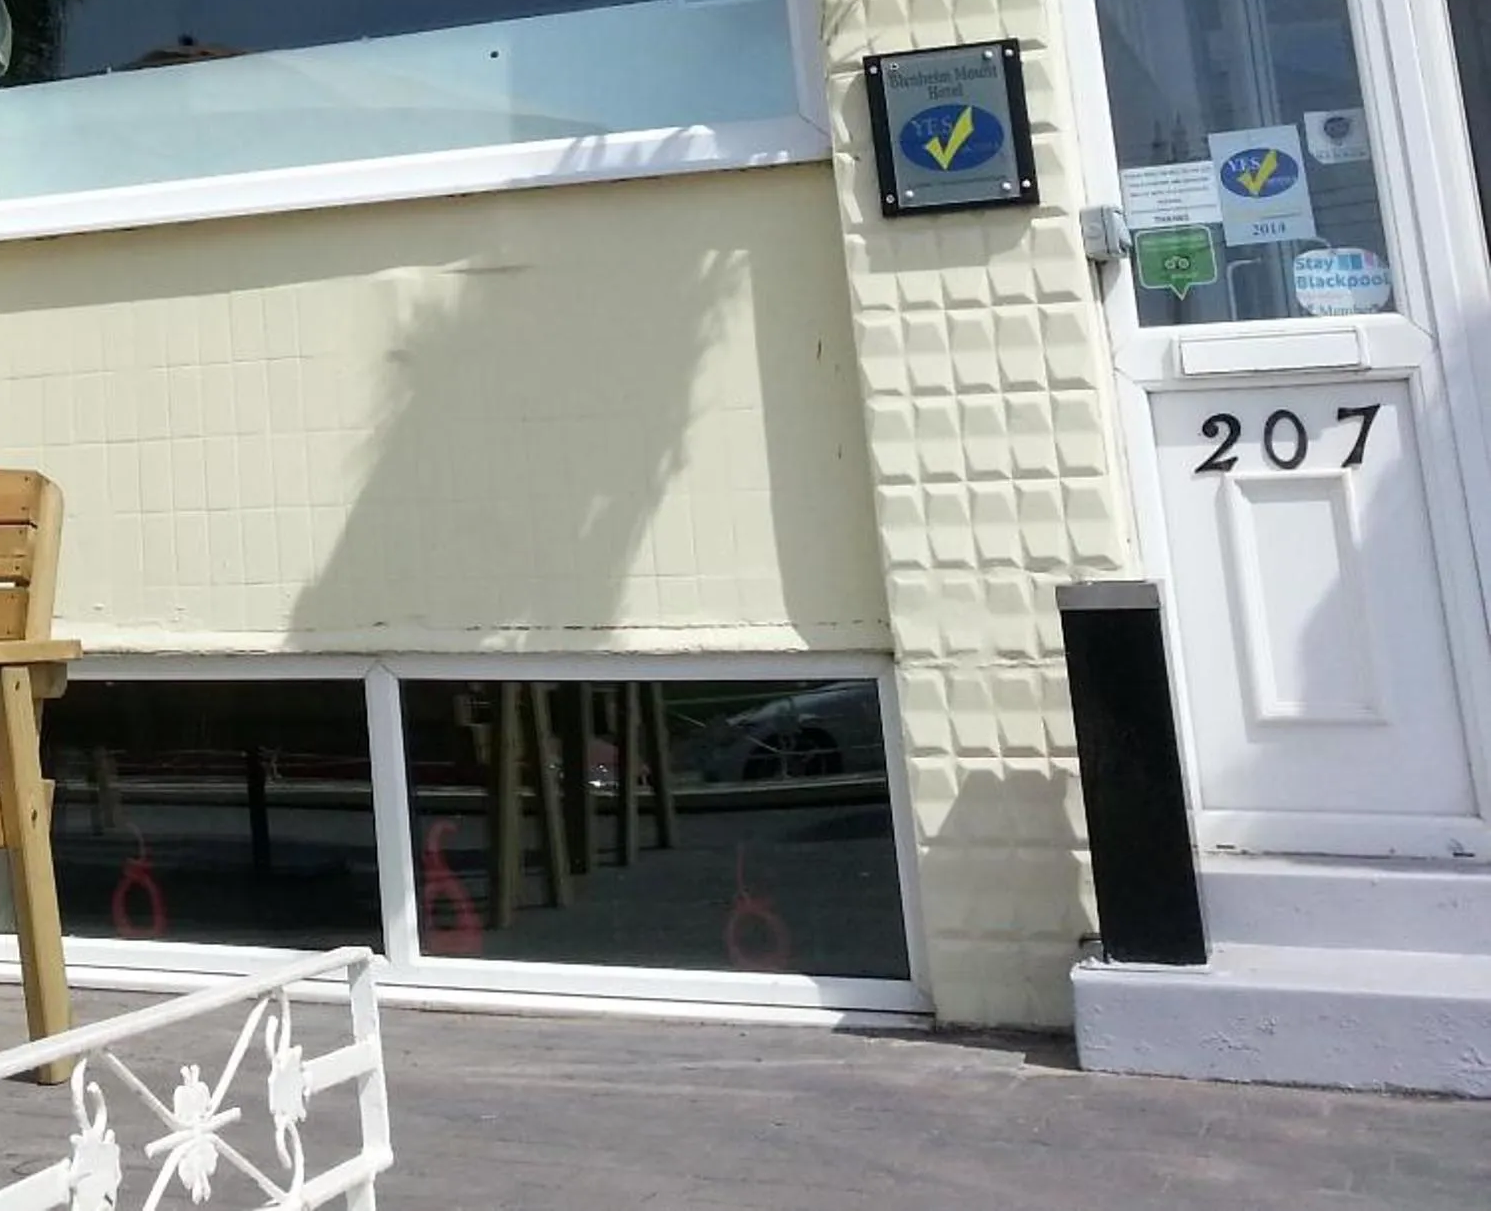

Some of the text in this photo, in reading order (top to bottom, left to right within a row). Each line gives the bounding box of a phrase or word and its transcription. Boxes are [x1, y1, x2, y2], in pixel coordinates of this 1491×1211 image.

[1228, 155, 1261, 173] YES
[1295, 256, 1334, 273] Stay
[1295, 272, 1393, 290] Blackpool
[1194, 403, 1381, 474] 207
